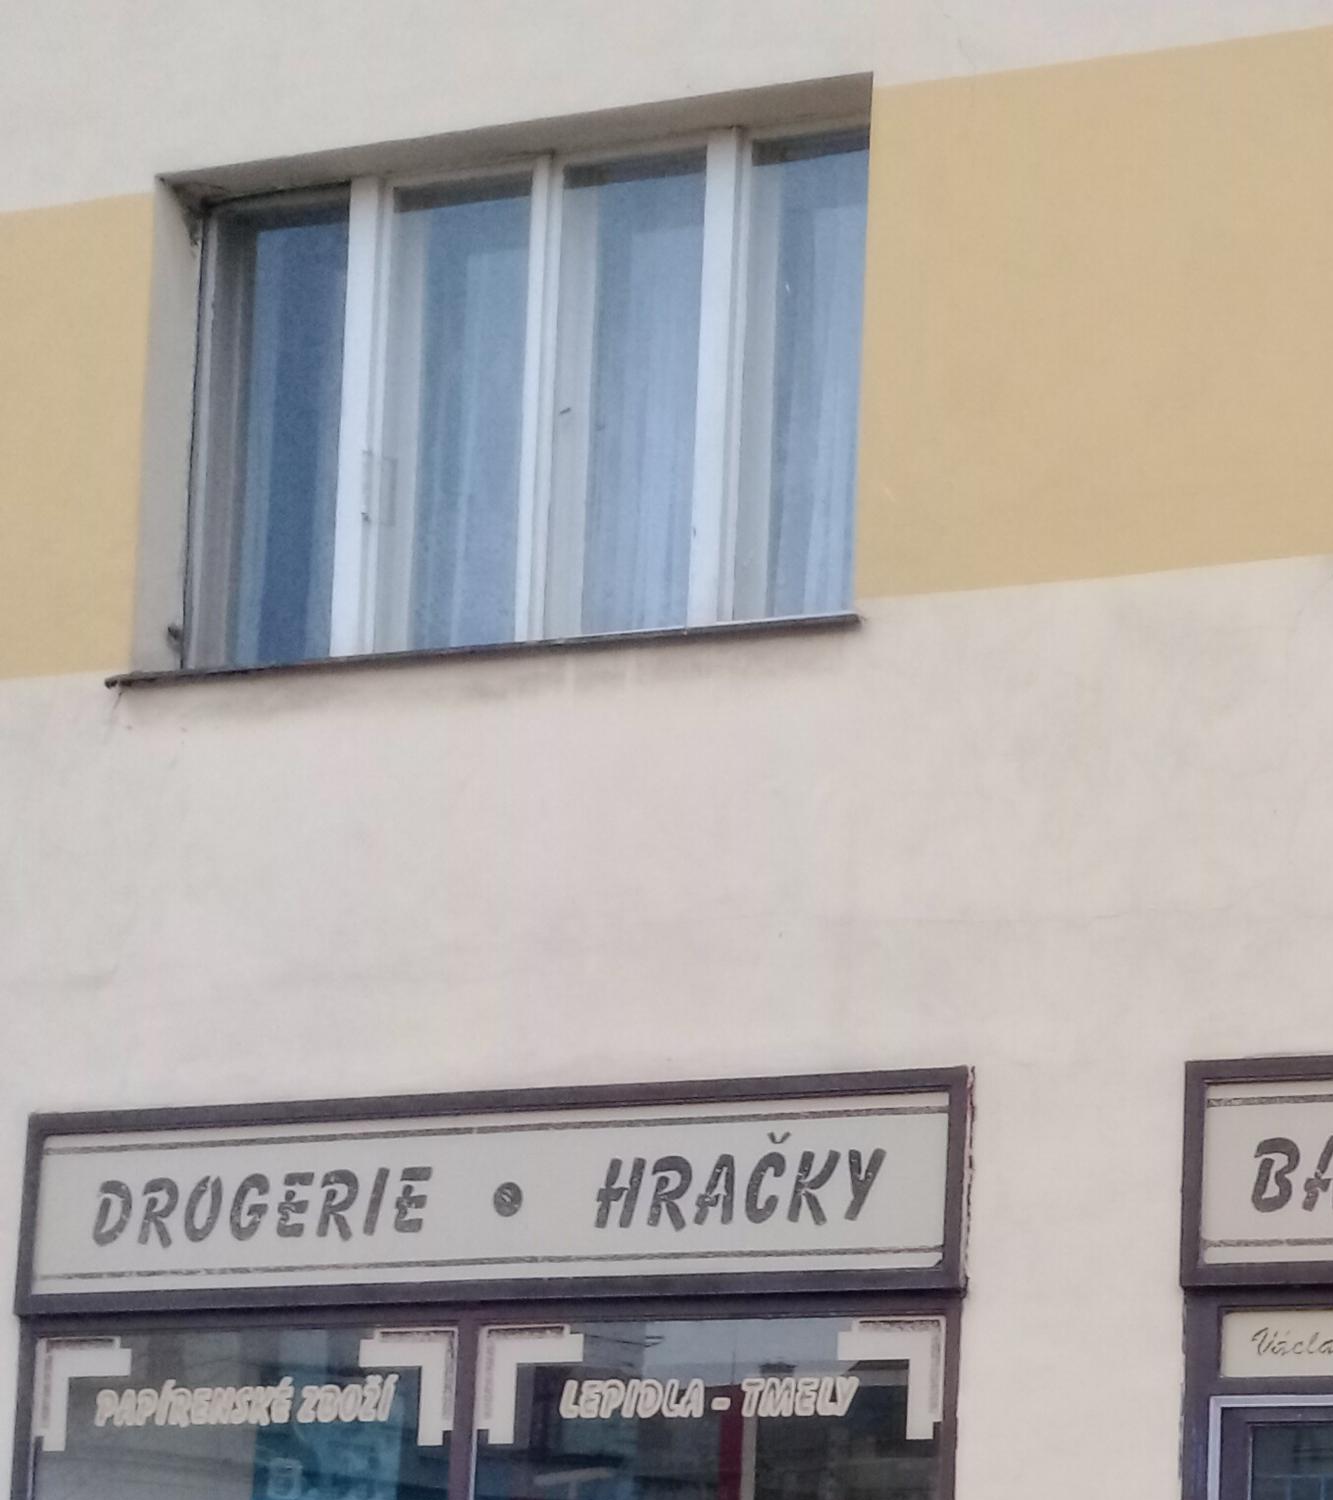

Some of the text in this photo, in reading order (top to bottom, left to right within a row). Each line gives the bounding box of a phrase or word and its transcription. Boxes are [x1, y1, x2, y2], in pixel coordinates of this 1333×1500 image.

[92, 1131, 887, 1249] DROGERIE HRAČKY
[94, 1373, 400, 1428] PAPÍRENSKÉ ZBOŽÍ
[559, 1377, 705, 1419] LEPIDLA
[741, 1375, 861, 1418] TMELY
